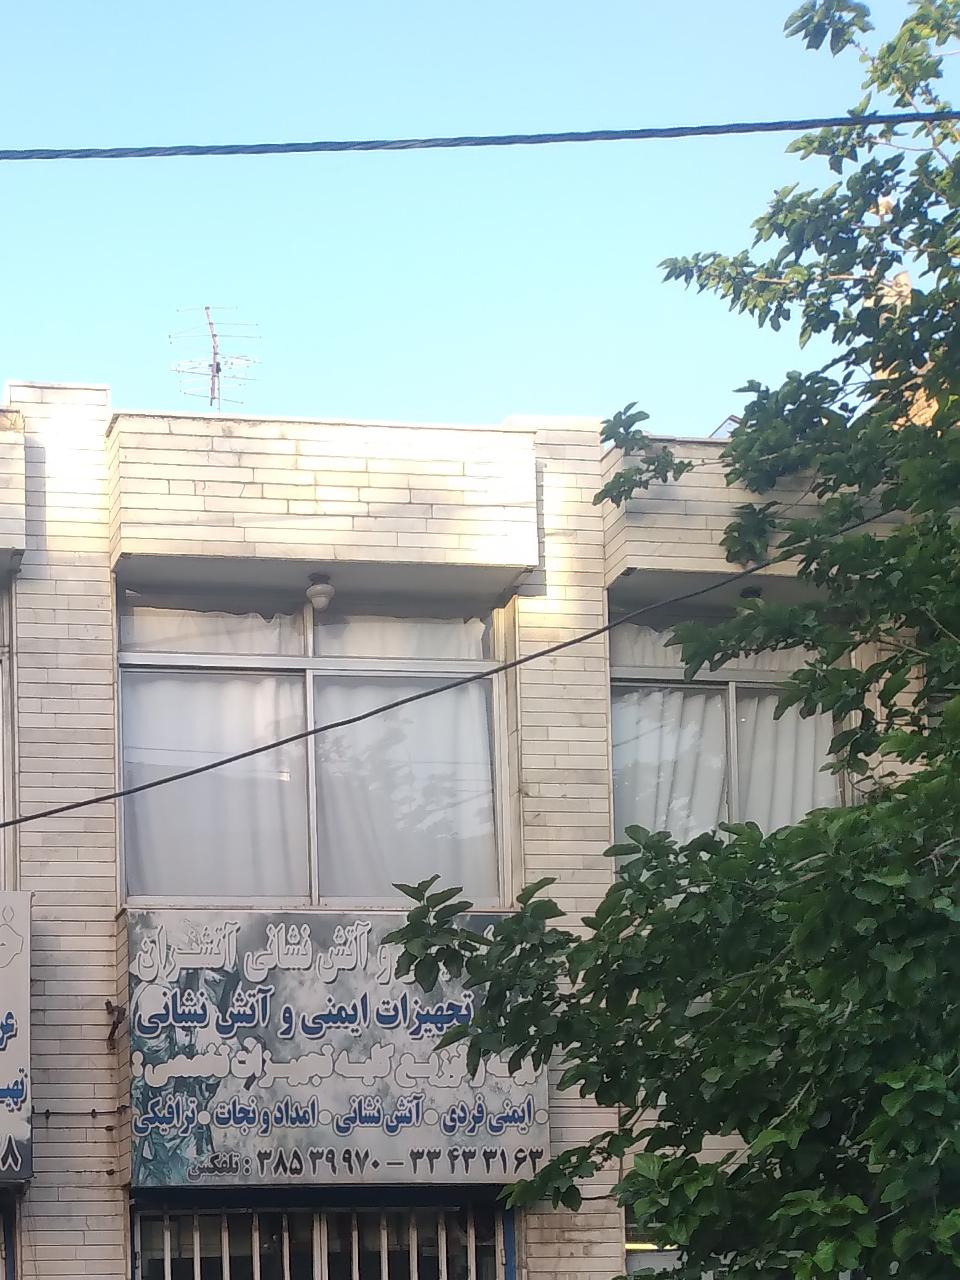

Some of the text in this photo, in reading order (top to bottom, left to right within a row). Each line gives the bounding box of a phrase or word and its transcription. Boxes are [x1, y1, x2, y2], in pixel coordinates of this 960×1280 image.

[243, 922, 314, 983] نشانی
[135, 987, 211, 1038] نشانی
[214, 984, 276, 1038] آتش
[277, 1003, 295, 1038] و
[299, 990, 370, 1037] ایمنی
[132, 1092, 535, 1137] ایمنی فردی آتش نشانی امداد و نجات ترافیکی
